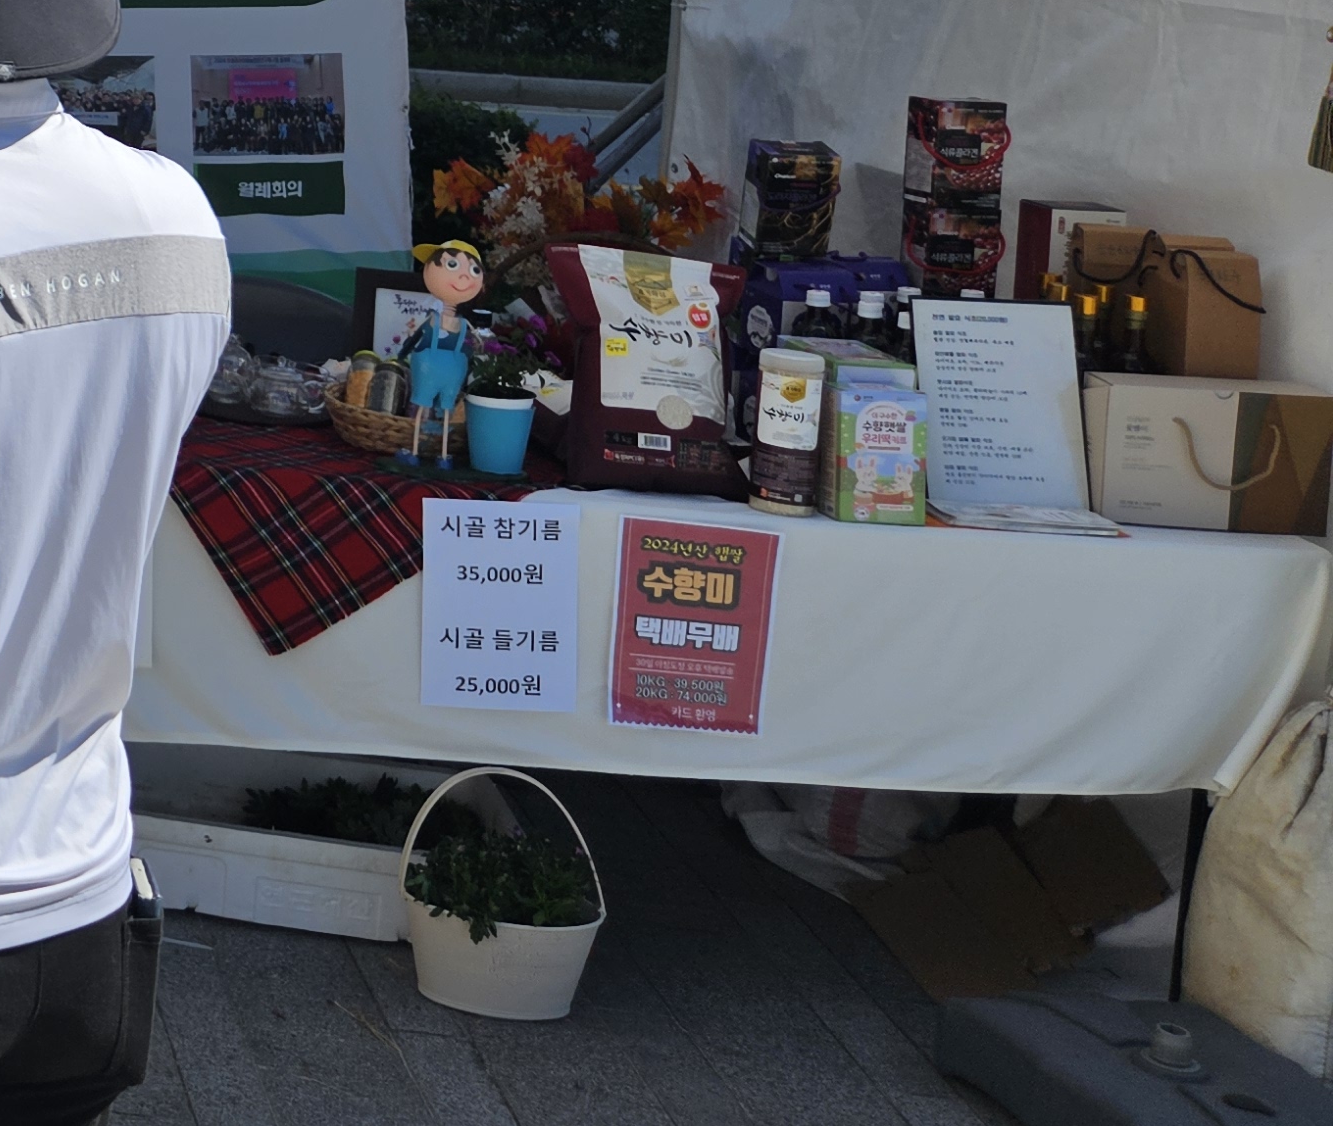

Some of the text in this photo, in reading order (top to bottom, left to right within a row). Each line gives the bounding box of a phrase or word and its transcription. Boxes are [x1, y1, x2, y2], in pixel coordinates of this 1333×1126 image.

[237, 180, 304, 199] 월례회의
[47, 266, 121, 294] HOGAN
[608, 317, 694, 349] 수향미
[440, 513, 563, 543] 시골 참기름
[642, 537, 708, 558] 2024년산
[456, 564, 544, 586] 35,000원
[642, 566, 735, 606] 수향미
[438, 625, 561, 654] 시골 들기름
[635, 615, 741, 653] 택배무배
[454, 675, 543, 697] 25,000원
[636, 673, 666, 687] 10KG
[635, 686, 669, 700] 20KG
[671, 706, 693, 721] 카드
